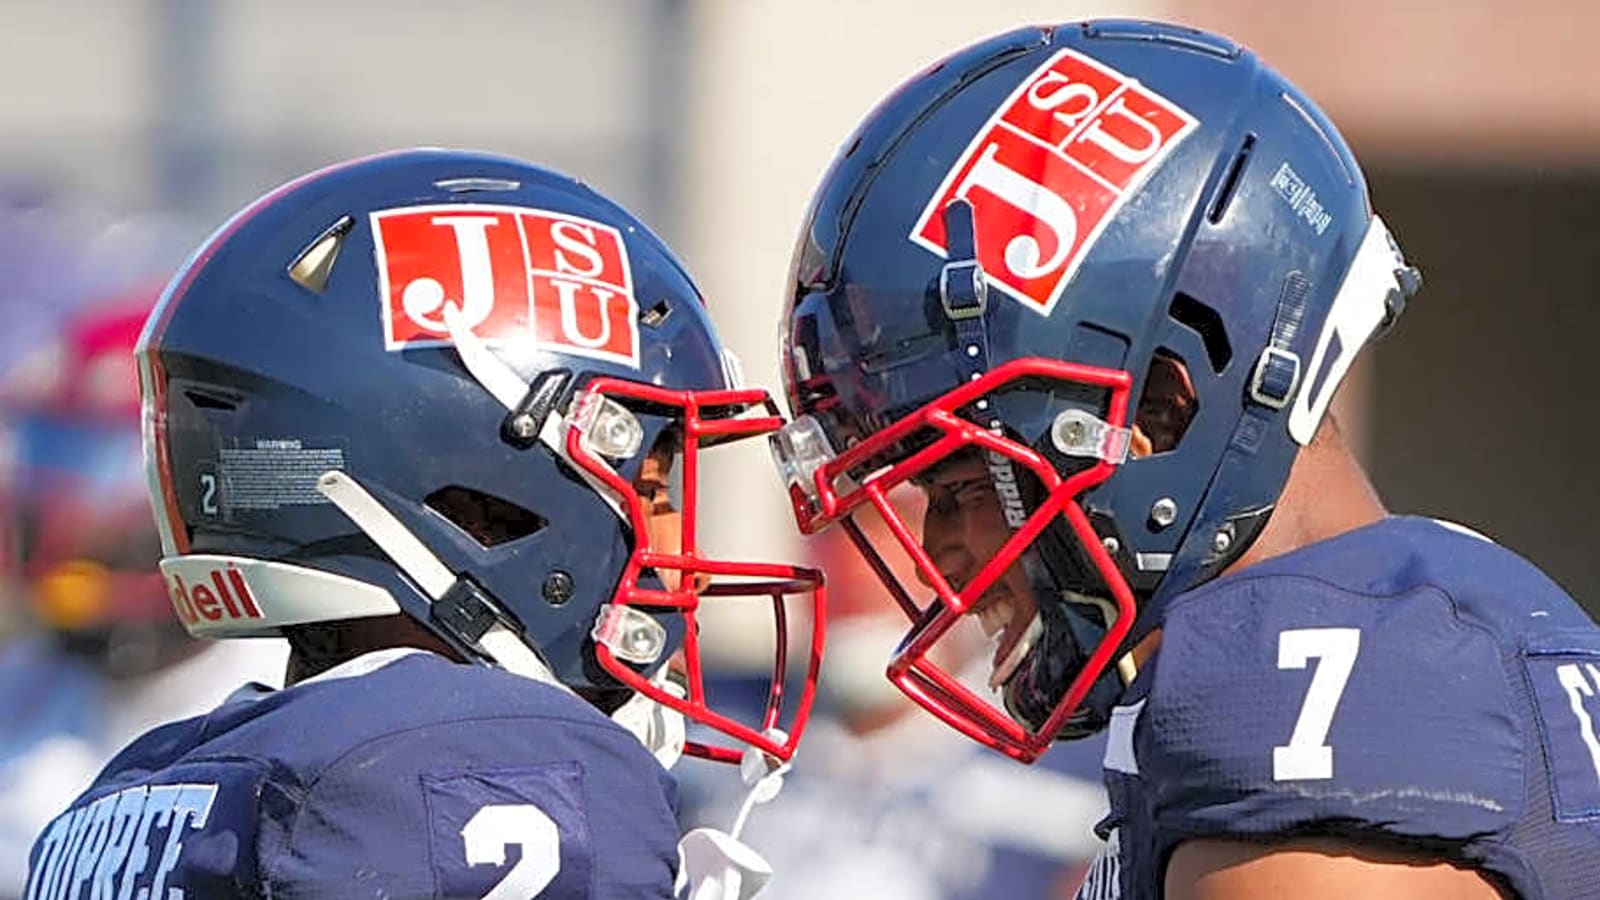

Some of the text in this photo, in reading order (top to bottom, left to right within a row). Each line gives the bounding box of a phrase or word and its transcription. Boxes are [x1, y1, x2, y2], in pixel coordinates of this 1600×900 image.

[201, 475, 217, 514] 2
[989, 428, 1027, 528] Ridde
[1273, 628, 1361, 781] 7
[459, 804, 561, 900] 2
